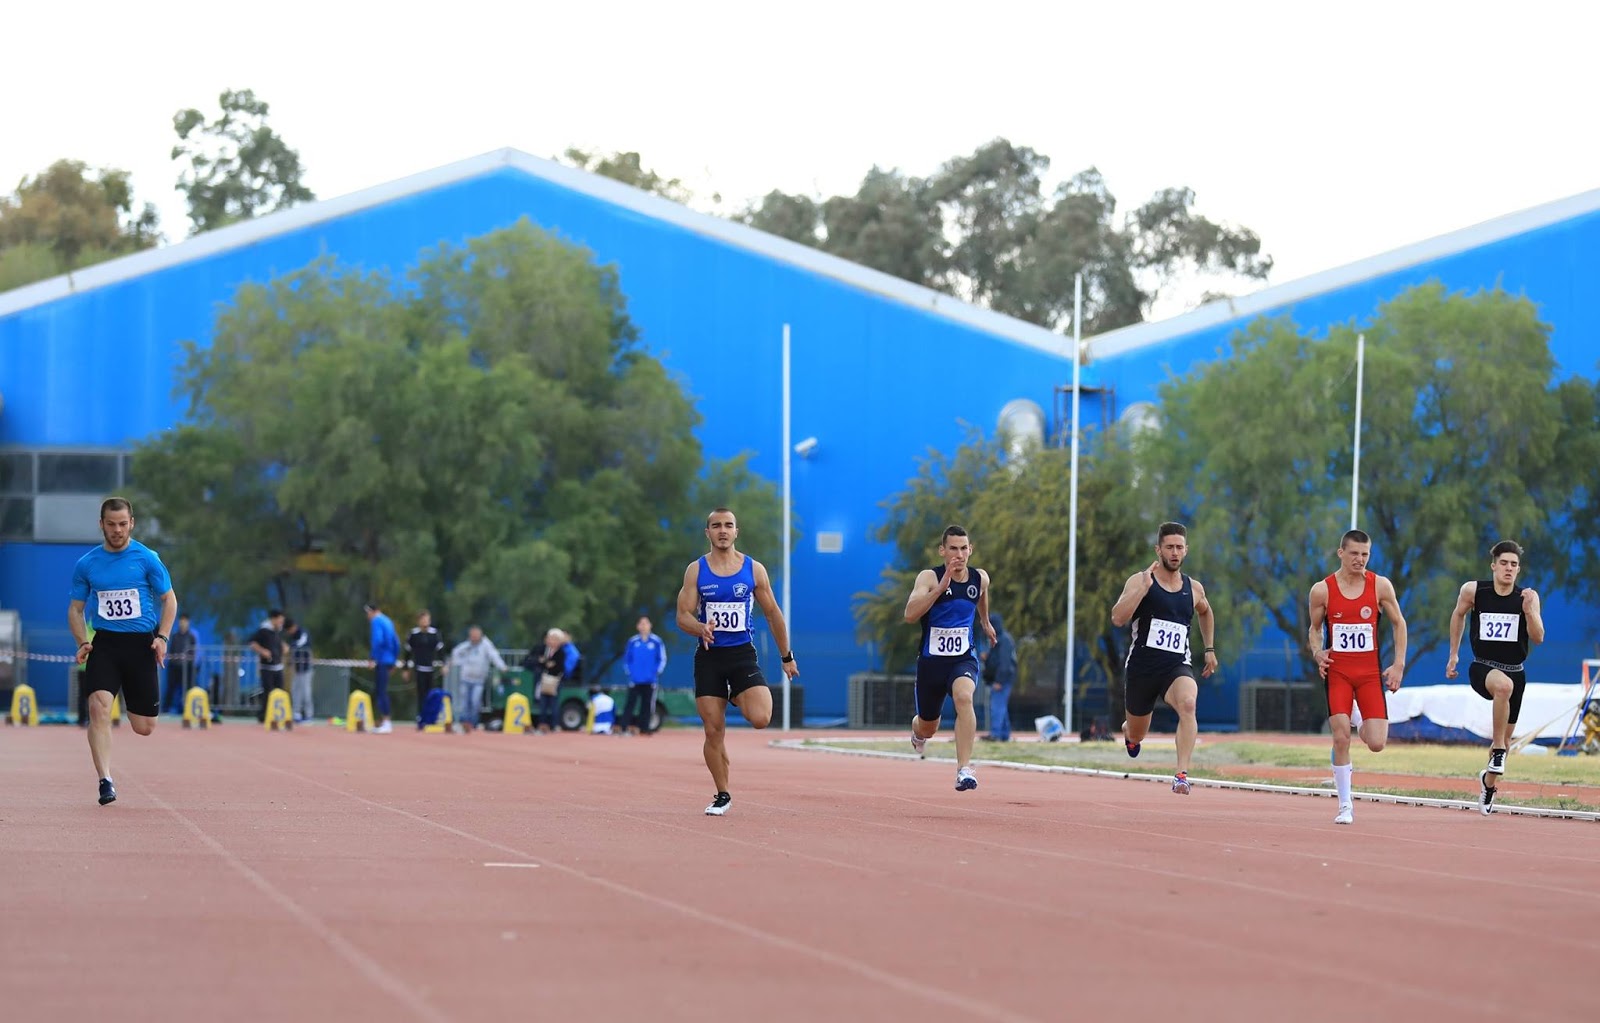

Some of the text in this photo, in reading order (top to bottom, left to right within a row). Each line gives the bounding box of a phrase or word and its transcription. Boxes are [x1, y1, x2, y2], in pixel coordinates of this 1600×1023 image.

[106, 599, 132, 617] 333
[712, 611, 739, 629] 330
[1486, 621, 1512, 638] 327
[937, 636, 962, 653] 309
[1155, 629, 1181, 650] 318
[1340, 632, 1366, 649] 310
[19, 695, 31, 716] 8
[191, 697, 204, 718] 6
[273, 699, 286, 720] 5
[513, 704, 526, 726] 2
